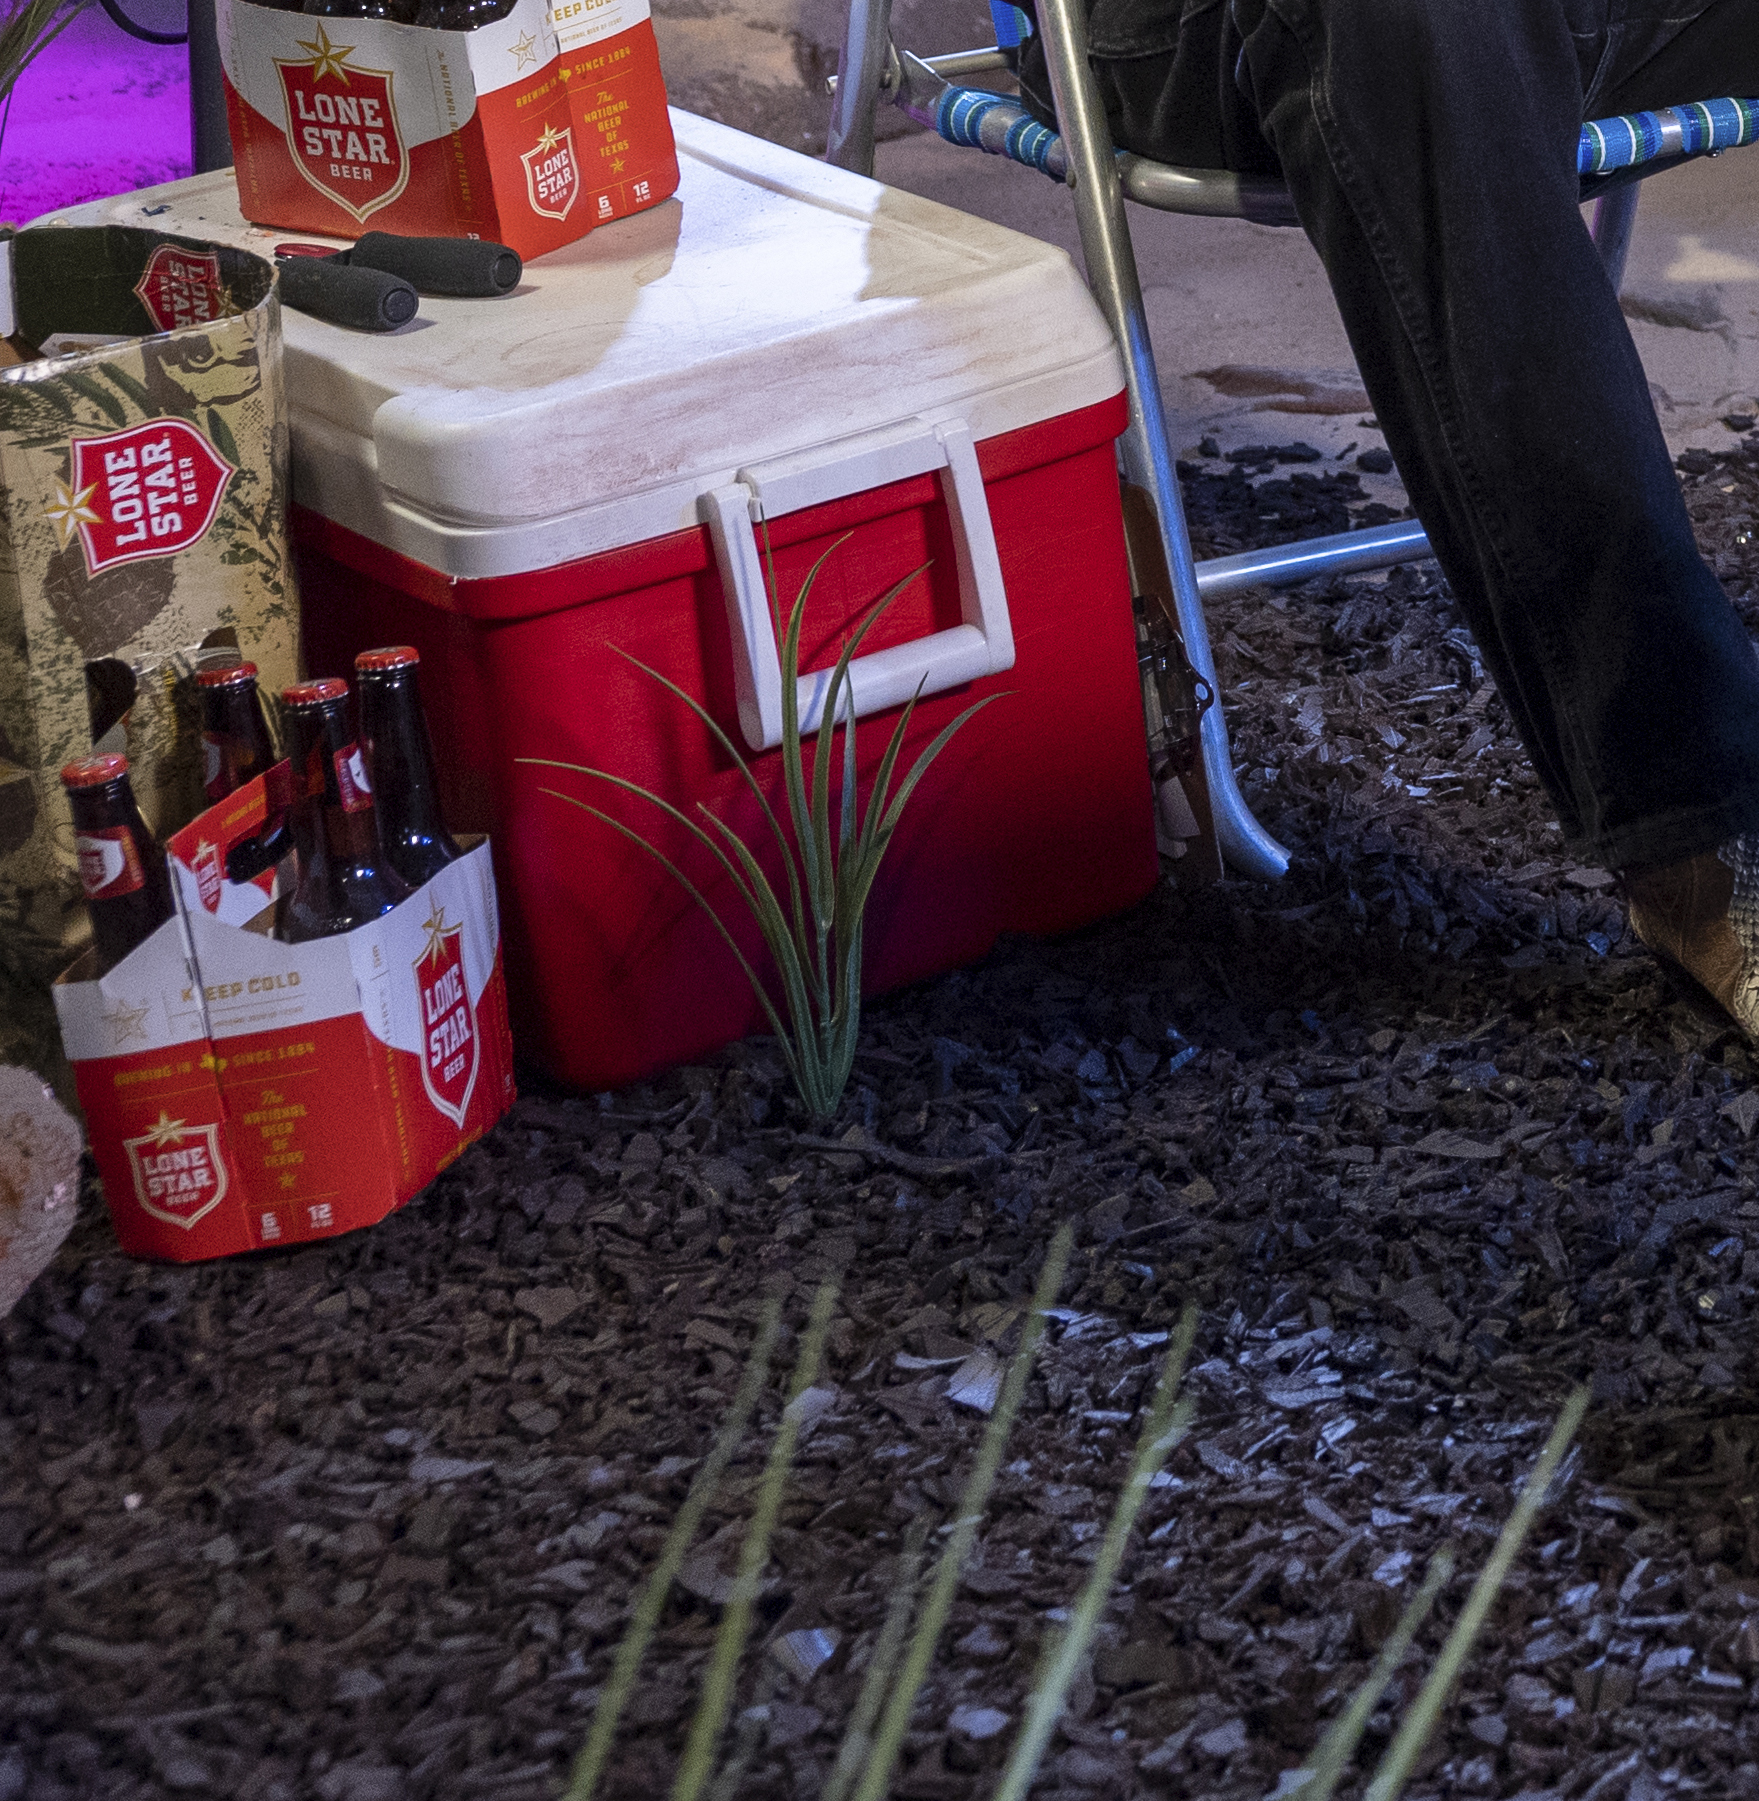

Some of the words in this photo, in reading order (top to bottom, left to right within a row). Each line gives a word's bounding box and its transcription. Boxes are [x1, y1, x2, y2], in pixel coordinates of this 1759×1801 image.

[294, 89, 385, 129] LONE
[302, 125, 391, 165] STAR
[329, 163, 373, 182] BEER
[534, 148, 569, 181] LONE
[537, 166, 573, 199] STAR
[549, 187, 568, 204] BEER
[632, 180, 650, 197] 12
[186, 263, 211, 329] LON
[104, 446, 147, 547] LONE
[140, 437, 183, 538] STAR
[179, 456, 200, 506] BEER
[424, 962, 465, 1027] LONE
[430, 1005, 473, 1069] STAR
[142, 1145, 209, 1176] LONE
[147, 1167, 213, 1198] STAR
[307, 1202, 332, 1221] 12
